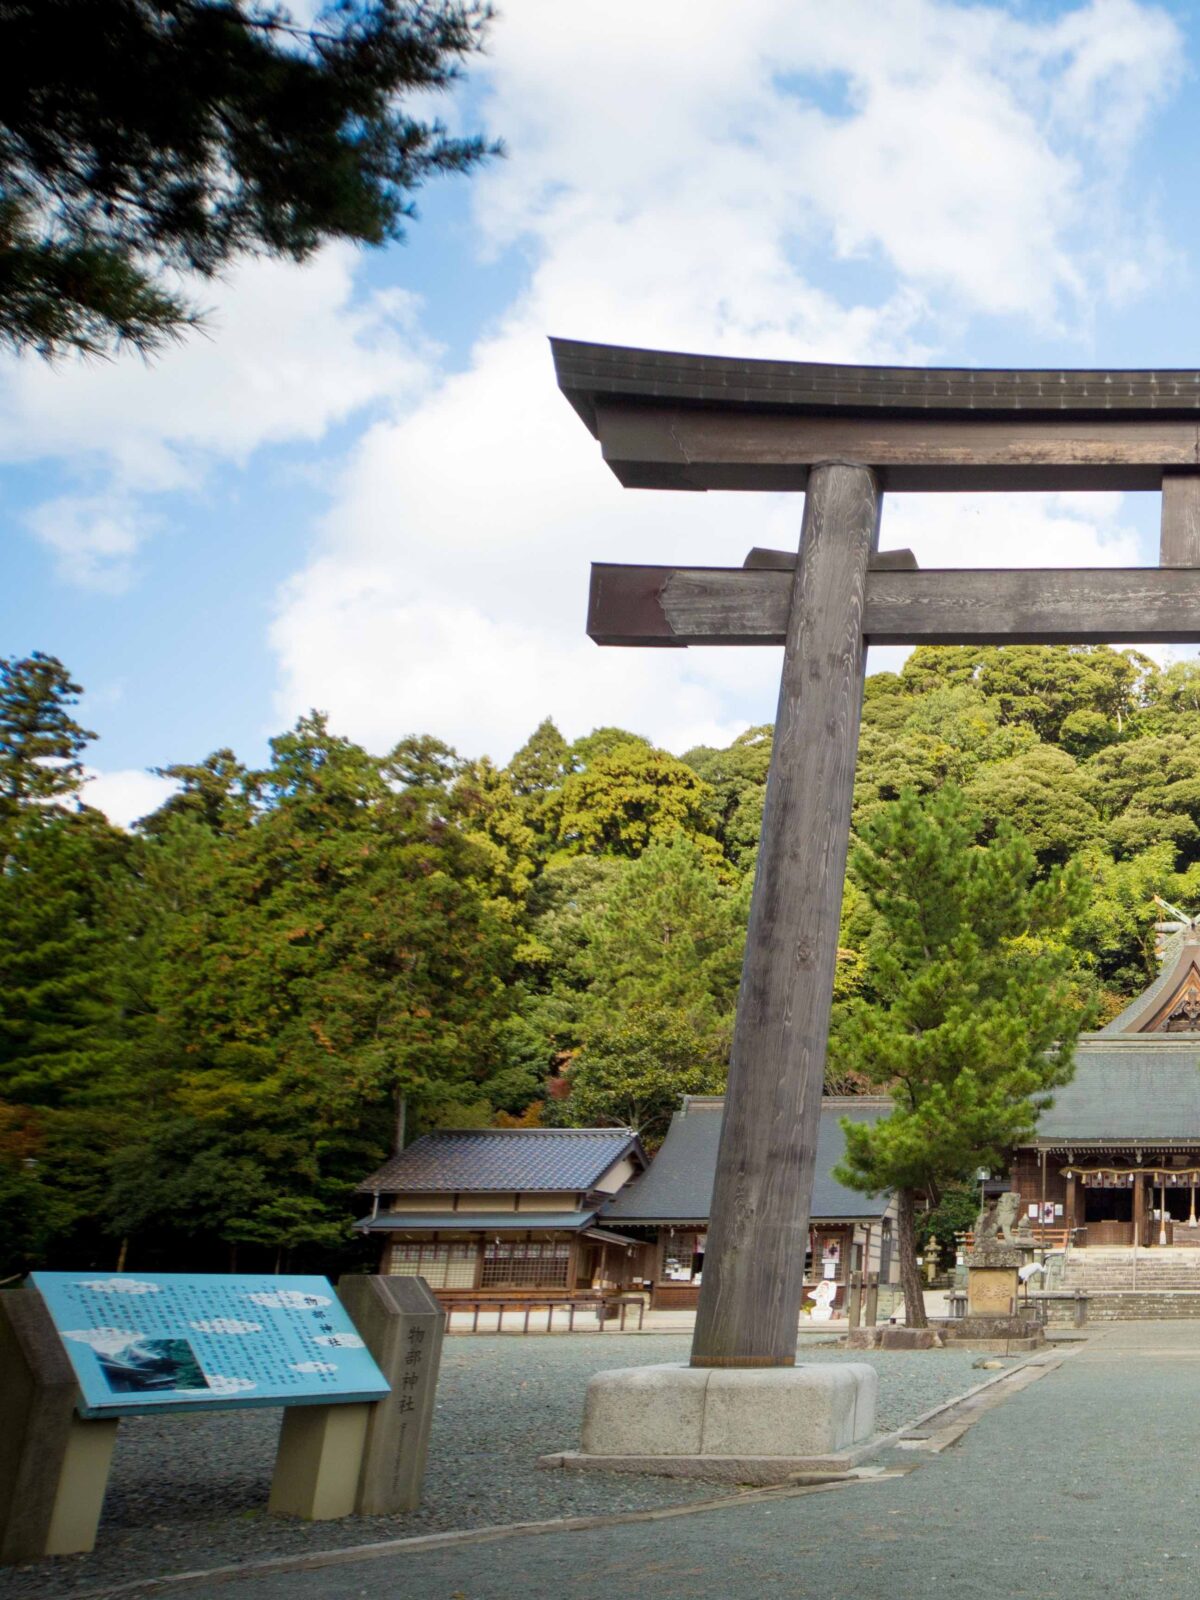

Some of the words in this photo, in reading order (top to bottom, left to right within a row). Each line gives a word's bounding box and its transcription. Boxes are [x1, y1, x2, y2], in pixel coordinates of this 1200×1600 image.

[304, 1296, 342, 1347] 物部神社
[399, 1326, 425, 1414] 物部神社
